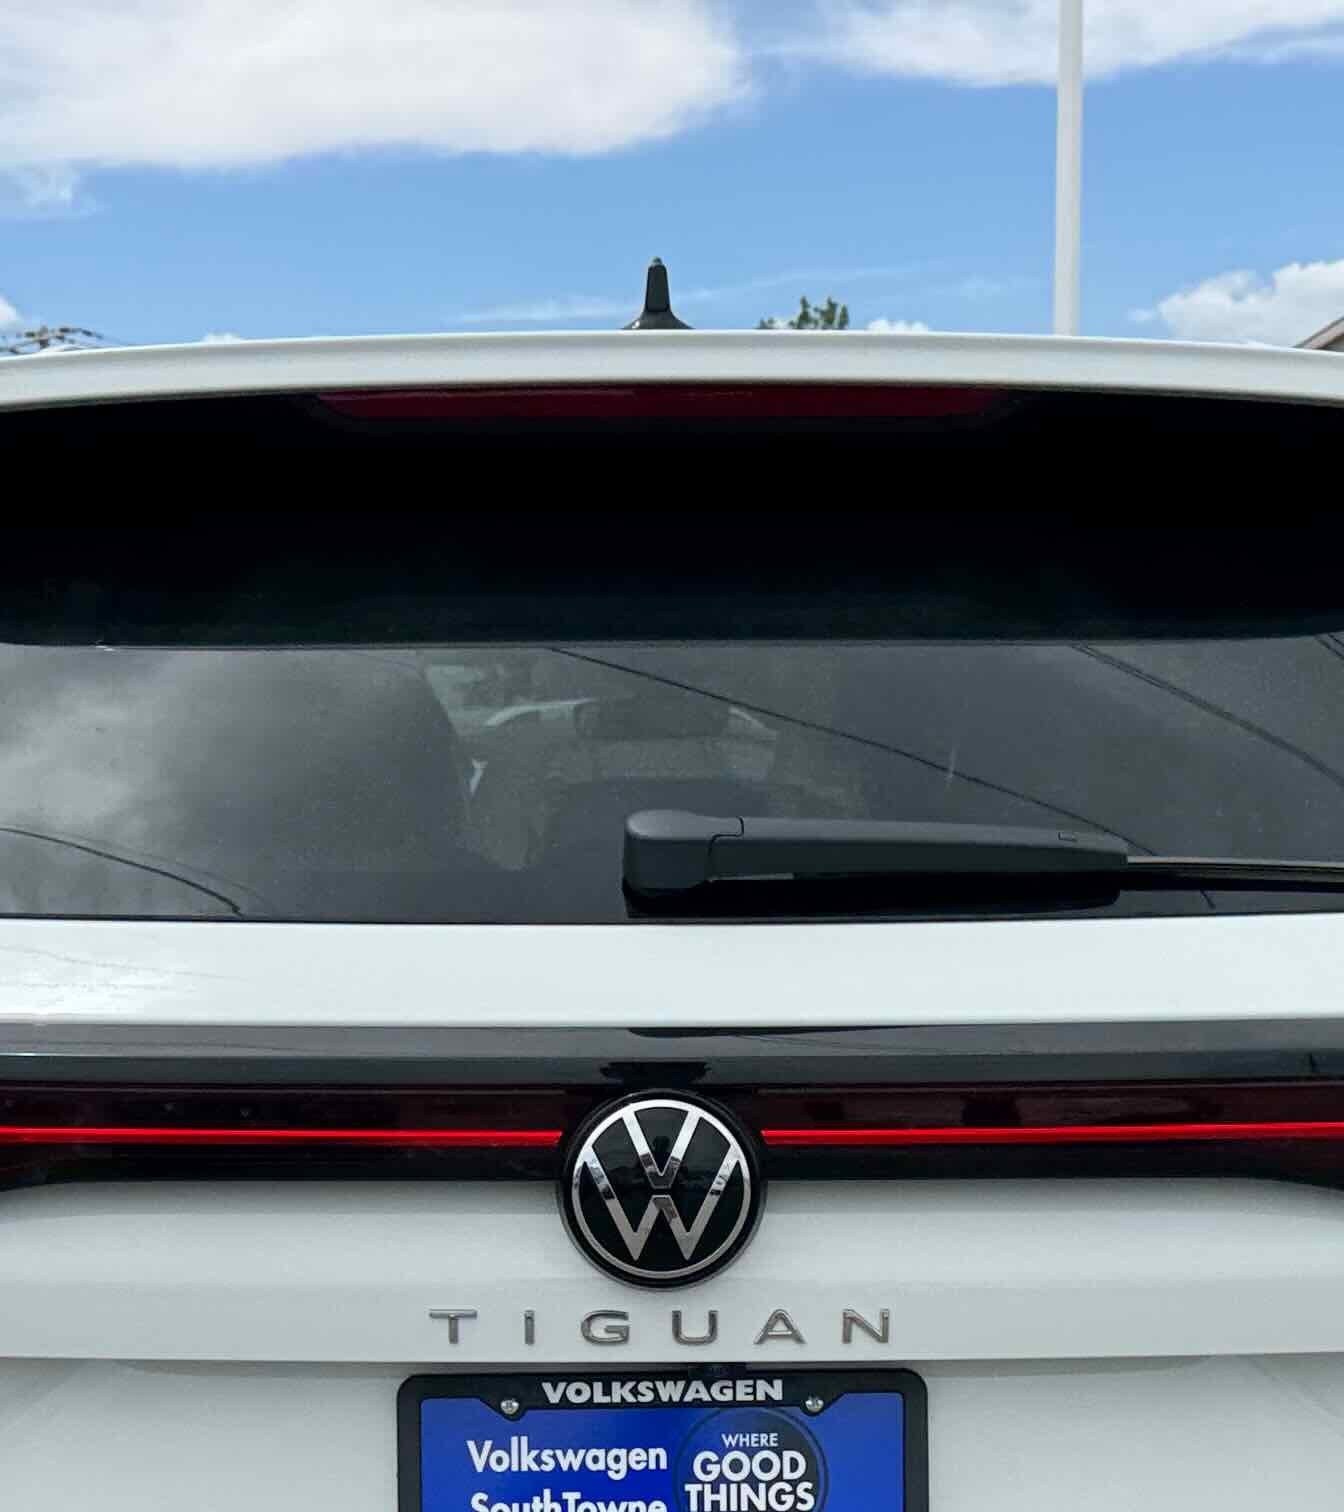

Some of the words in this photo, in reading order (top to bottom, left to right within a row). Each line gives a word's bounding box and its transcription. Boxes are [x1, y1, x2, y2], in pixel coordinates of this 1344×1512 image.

[571, 1098, 753, 1279] VW
[428, 1308, 890, 1346] TIGUAN
[542, 1379, 784, 1404] VOLKSWAGEN
[721, 1433, 779, 1448] WHERE
[466, 1436, 668, 1481] Volkswagen
[692, 1450, 807, 1482] GOOD
[684, 1481, 815, 1512] THINGS
